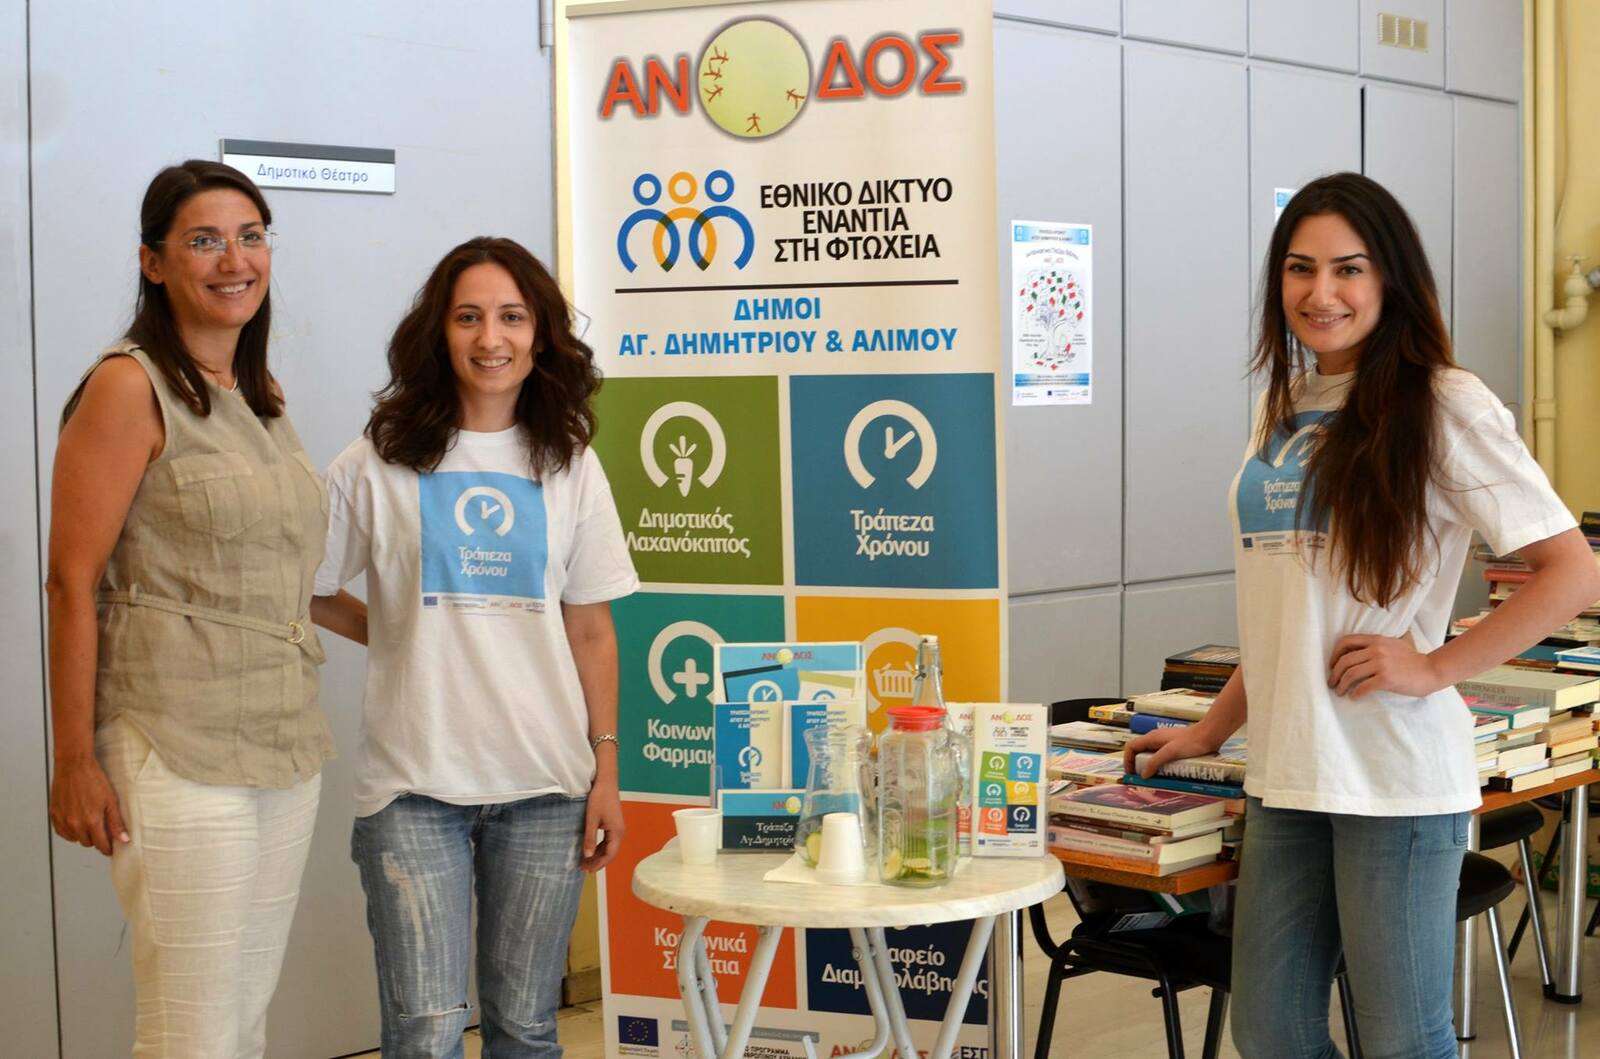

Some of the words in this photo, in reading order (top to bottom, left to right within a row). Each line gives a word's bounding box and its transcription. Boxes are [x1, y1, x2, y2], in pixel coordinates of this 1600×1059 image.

[257, 163, 317, 180] Δημοτικό
[321, 167, 368, 184] Θέατρο
[760, 181, 853, 209] ΕΘΝΙΚΟ
[857, 177, 953, 206] ΔΙΚΤΥΟ
[802, 207, 909, 235] ΕΝΑΝΤΙΑ
[773, 238, 820, 263] ΣΤΗ
[825, 234, 941, 262] ΦΤΩΧΕΙΑ
[734, 297, 822, 321] ΔΗΜΟΙ
[618, 333, 657, 356] ΑΓ.
[664, 330, 817, 356] ΔΗΜΗΤΡΙΟΥ
[825, 330, 843, 353] &
[852, 327, 958, 353] ΑΛΙΜΟΥ
[638, 507, 735, 532] Δημοτικός
[850, 508, 935, 536] Τράπεζα
[458, 546, 512, 563] Τράπεζα
[856, 534, 930, 560] Χρόνου
[461, 561, 508, 578] Χρόνου
[643, 742, 715, 768] Φαρμακ
[756, 822, 794, 834] Τράπεζα
[654, 926, 748, 954] Κονικά
[663, 950, 740, 976] Σίτια
[888, 944, 946, 969] αφείο
